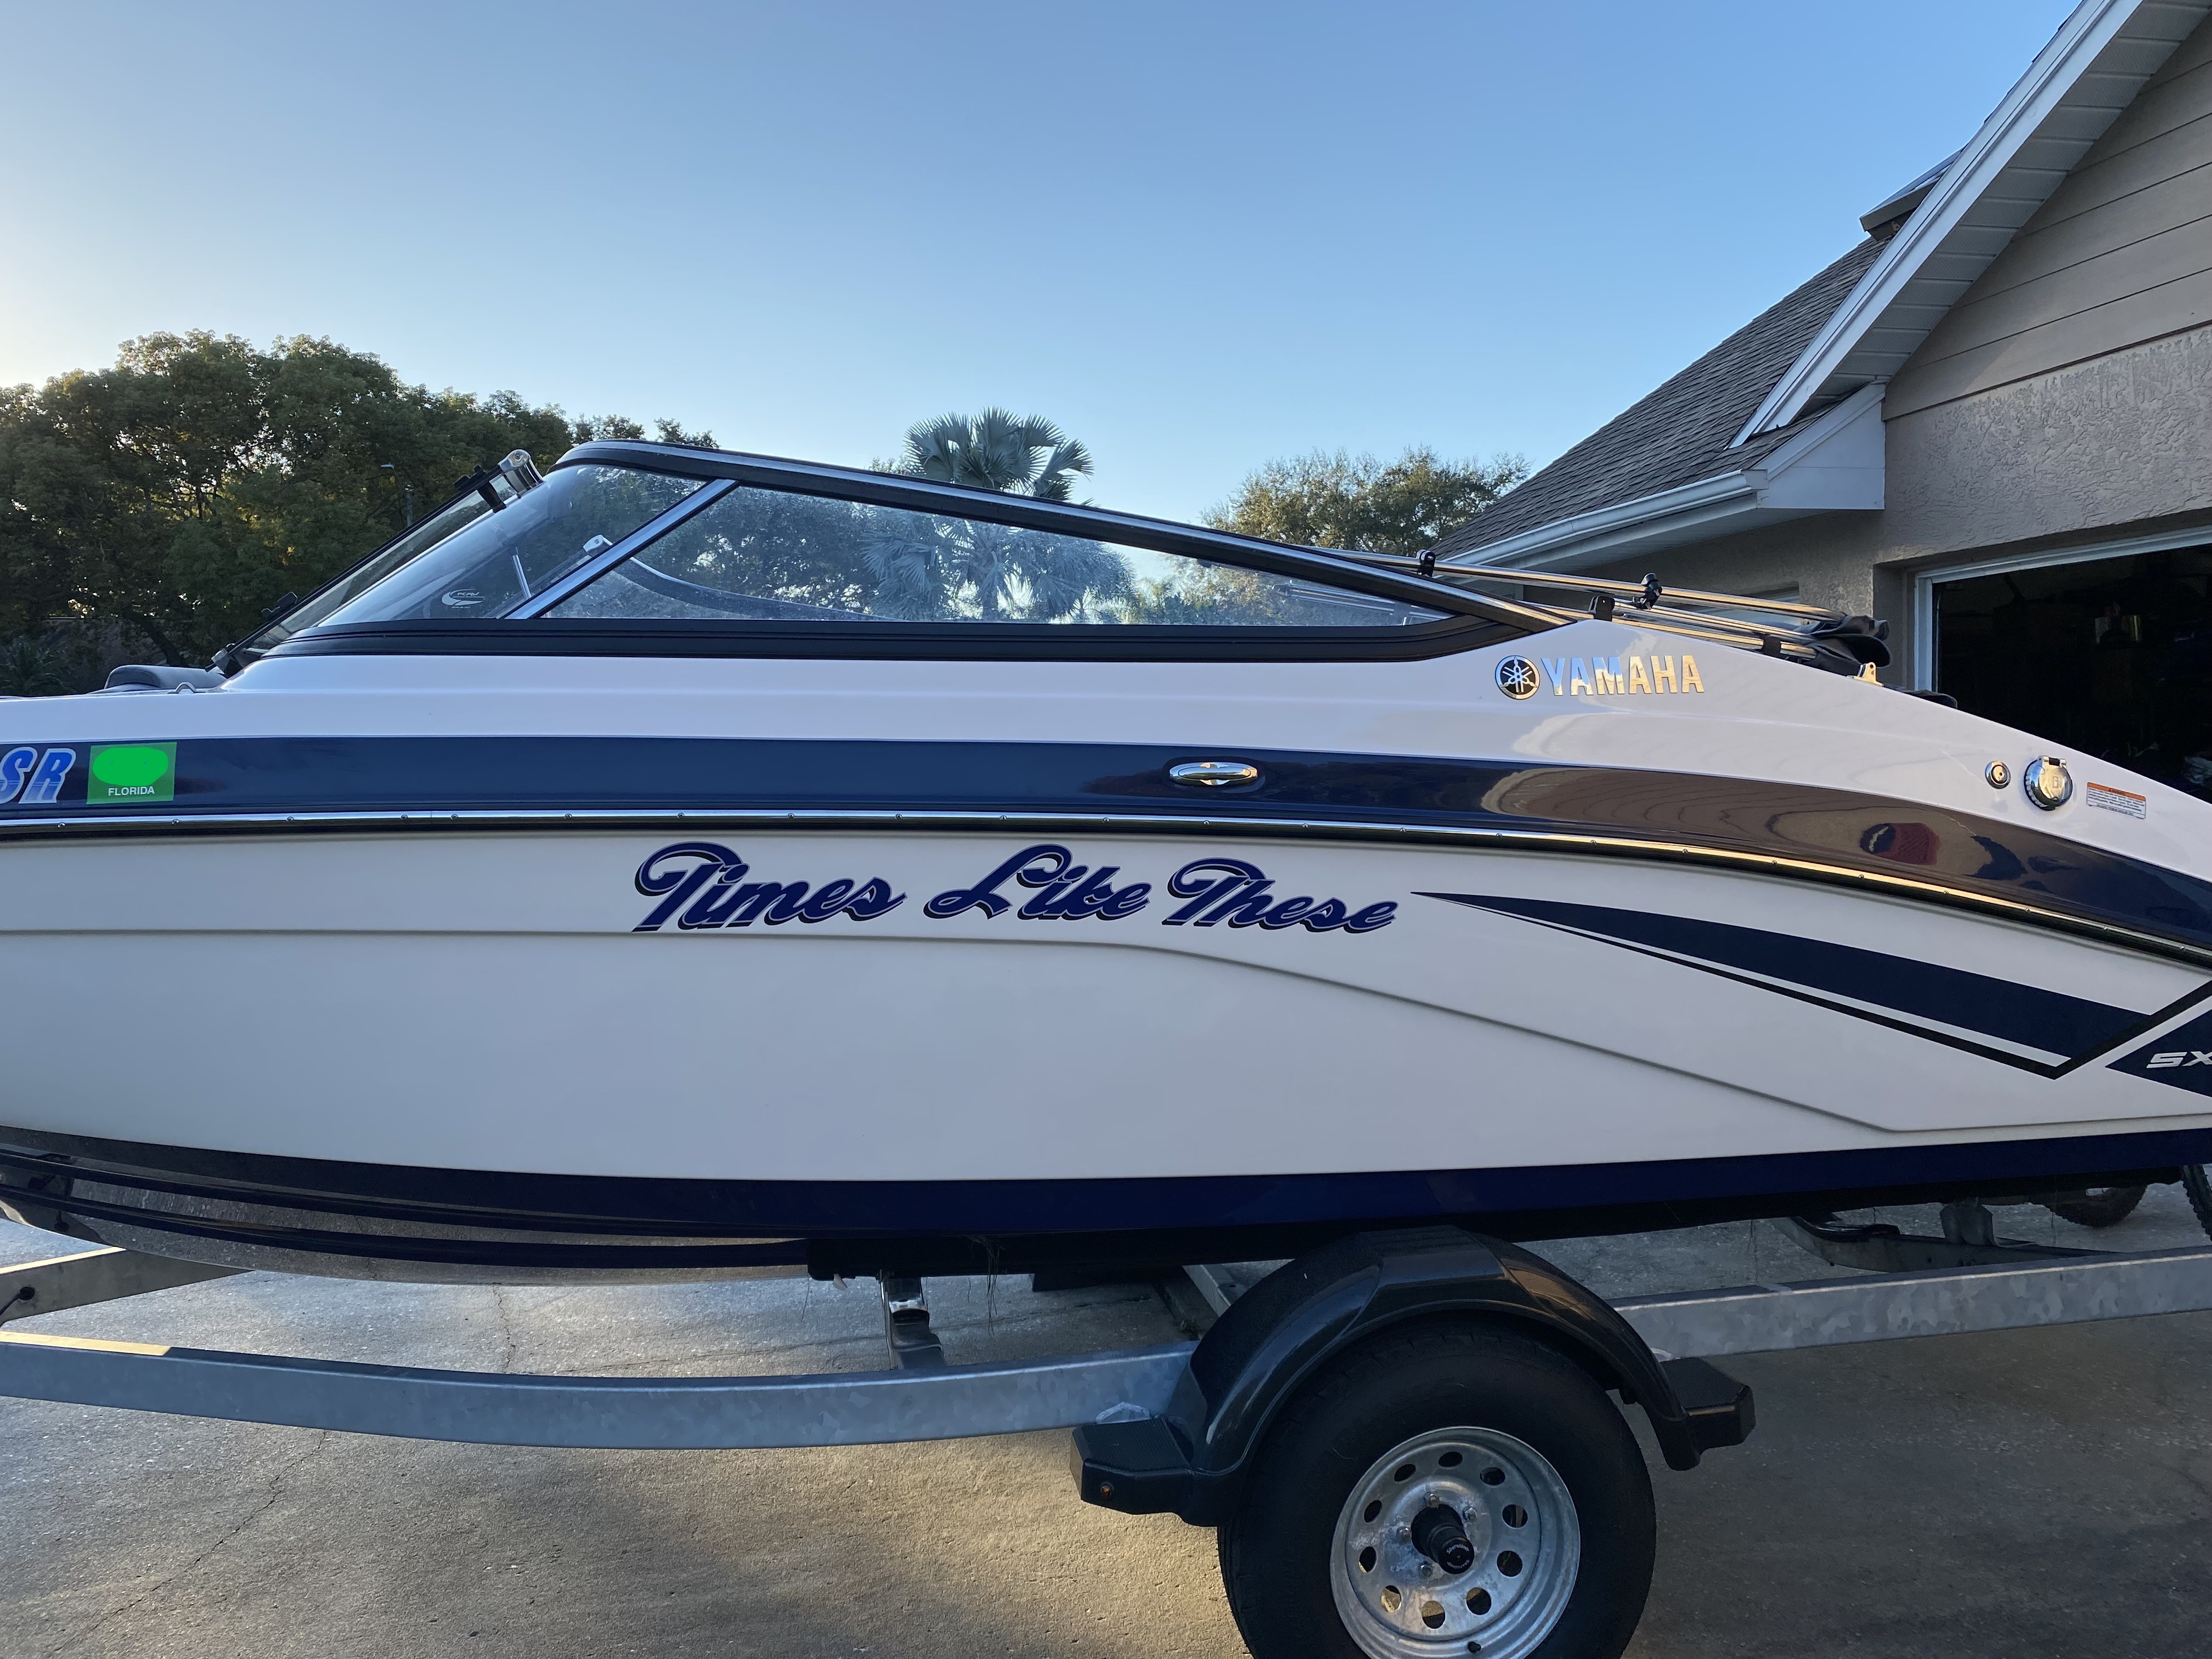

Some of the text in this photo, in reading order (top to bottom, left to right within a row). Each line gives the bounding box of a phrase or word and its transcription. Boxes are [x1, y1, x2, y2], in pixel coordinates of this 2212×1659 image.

[1541, 654, 1705, 696] YAMAHA
[0, 746, 76, 804] SR
[108, 786, 155, 796] FLORIDA
[631, 841, 1399, 934] Times Like These
[2146, 1051, 2212, 1069] SX
